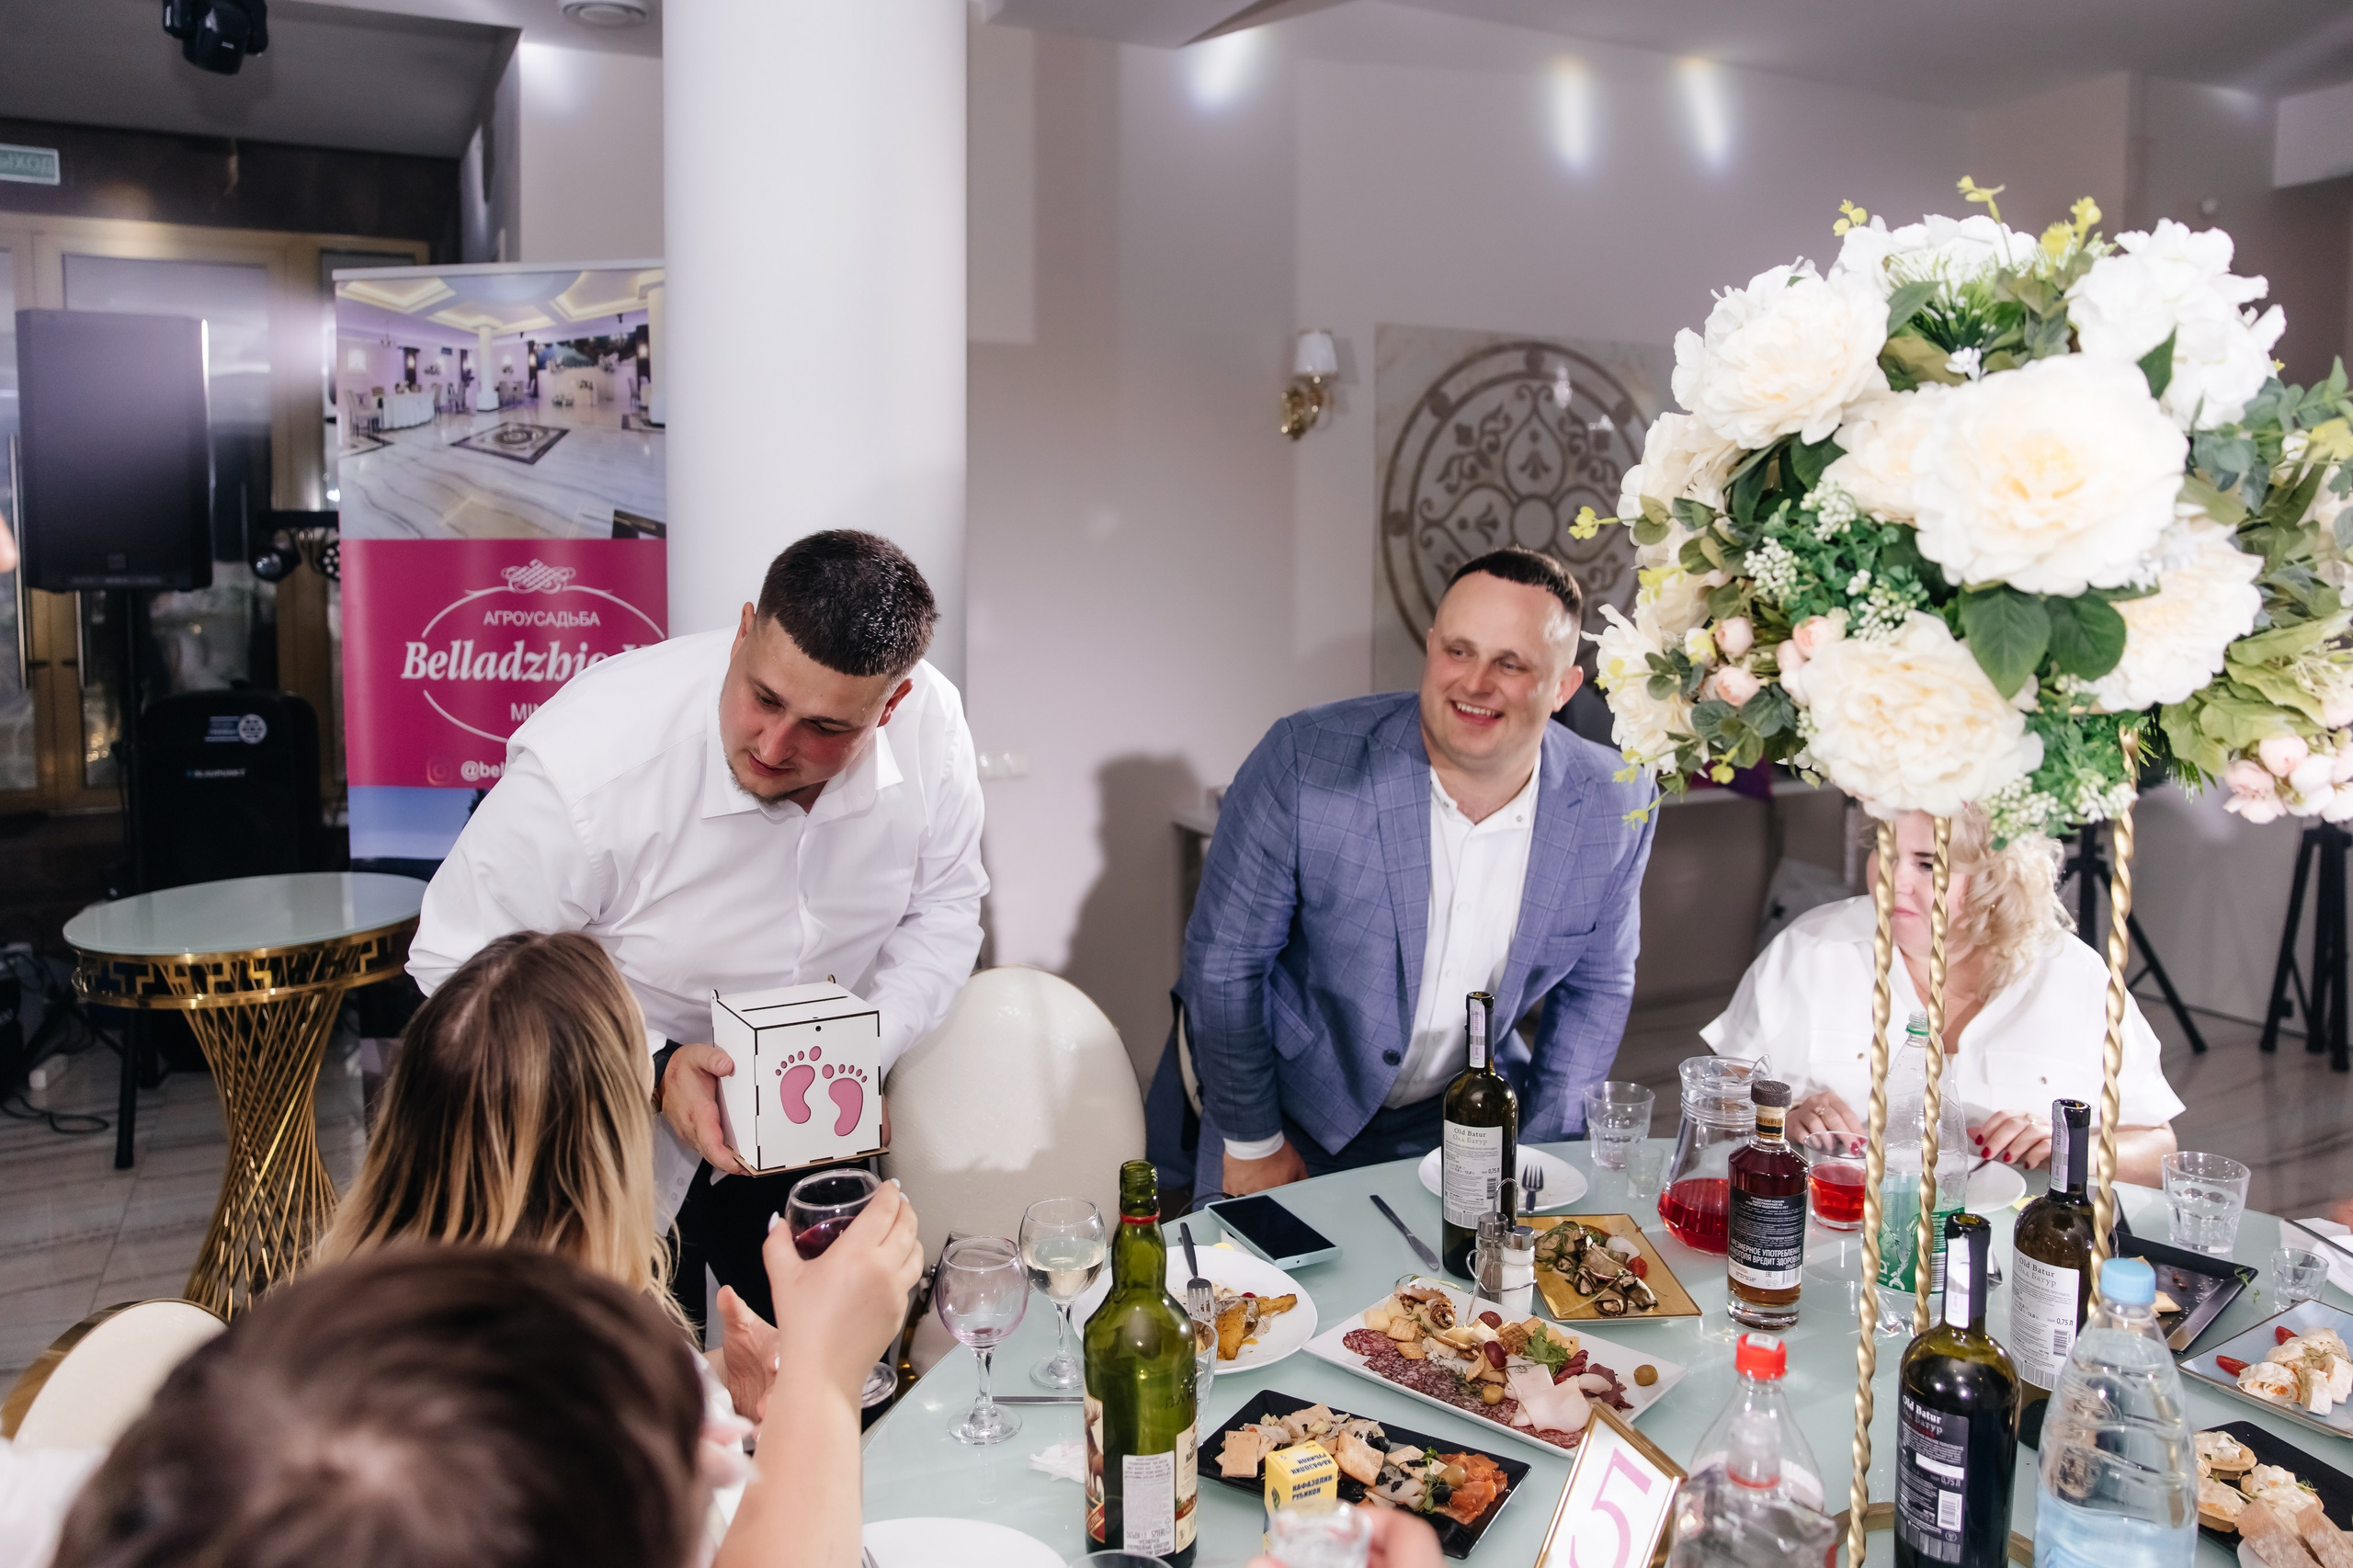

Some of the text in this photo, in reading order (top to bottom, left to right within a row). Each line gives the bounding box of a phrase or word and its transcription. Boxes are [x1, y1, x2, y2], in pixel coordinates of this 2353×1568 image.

[483, 610, 600, 628] АГРОУСАДЬБА
[1753, 1255, 1776, 1266] ВРЕДИТ
[2018, 1256, 2055, 1278] Old Batur
[2031, 1271, 2057, 1288] Батур
[2056, 1317, 2069, 1325] 0,75
[1902, 1394, 1942, 1425] Old Batur
[1569, 1447, 1653, 1568] 5
